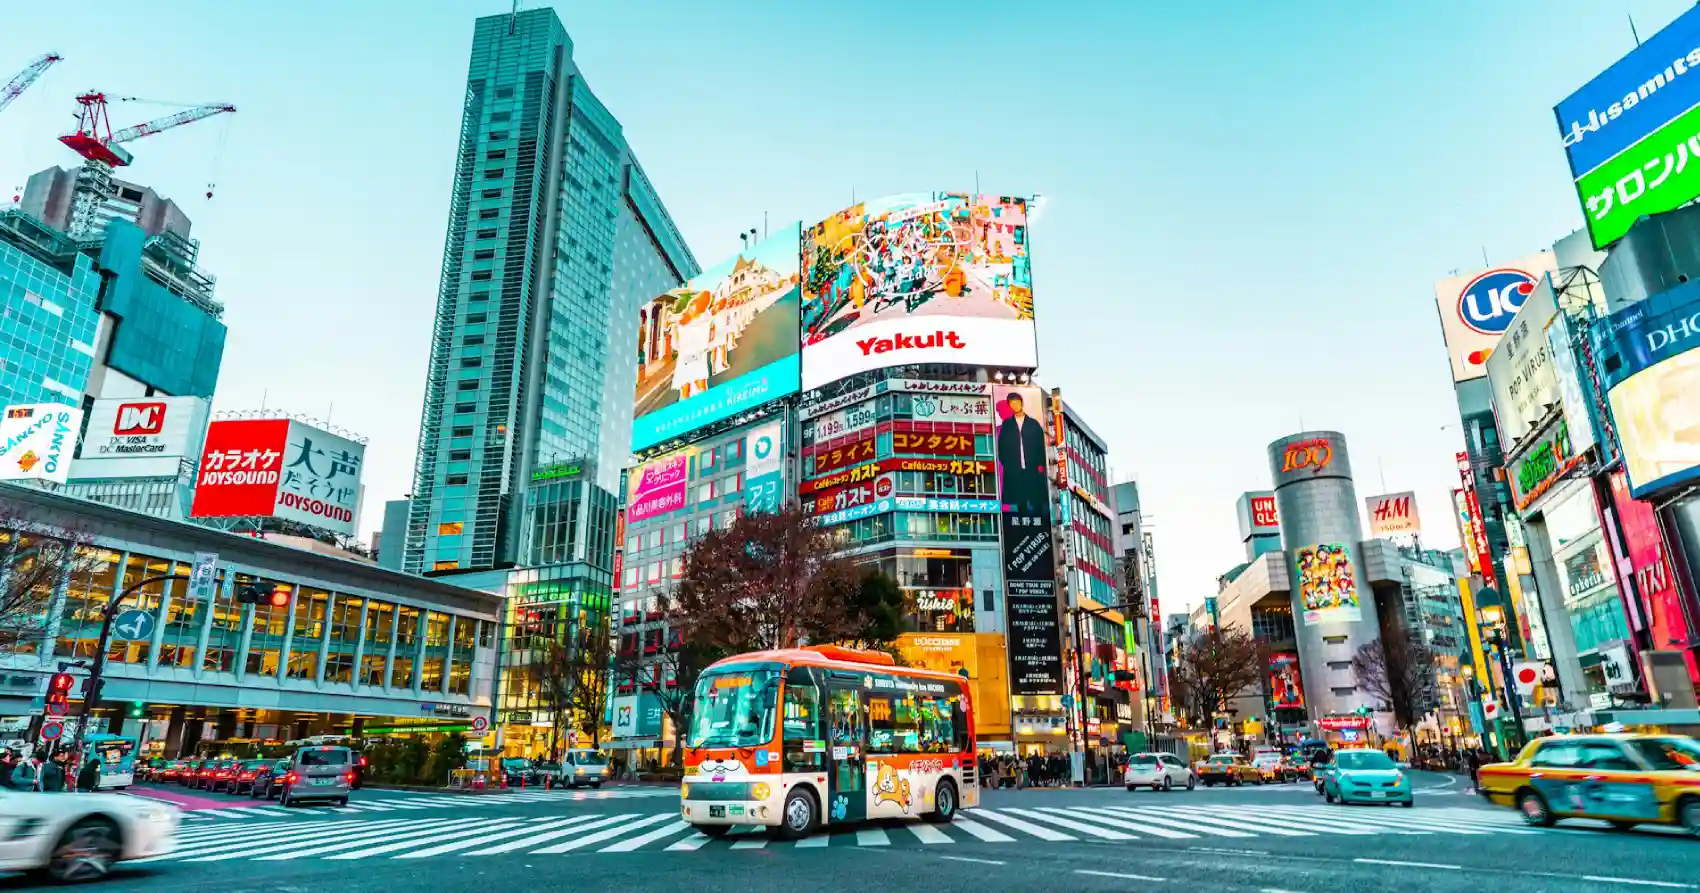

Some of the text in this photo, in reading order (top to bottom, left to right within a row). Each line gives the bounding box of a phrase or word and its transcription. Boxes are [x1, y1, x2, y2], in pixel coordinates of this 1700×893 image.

[856, 331, 966, 356] Yakult
[1509, 347, 1546, 400] POP VIRUS
[904, 381, 986, 393] しゃぶしゃぶバイキング
[940, 400, 988, 415] しゃぶ葉
[118, 407, 160, 431] DC
[45, 411, 72, 473] SANKYO
[127, 436, 147, 444] VISA
[803, 427, 814, 438] 9F
[893, 433, 972, 451] コンタクト
[115, 444, 166, 453] MasterCard
[286, 437, 360, 479] 大声
[205, 448, 280, 470] カラオケ
[950, 460, 987, 475] ガスト
[201, 470, 278, 486] JOYSOUND
[850, 463, 880, 482] ガスト
[278, 491, 353, 523] JOYSOUND
[835, 486, 871, 511] ガスト
[1255, 501, 1276, 512] UN
[1374, 496, 1409, 521] H&M
